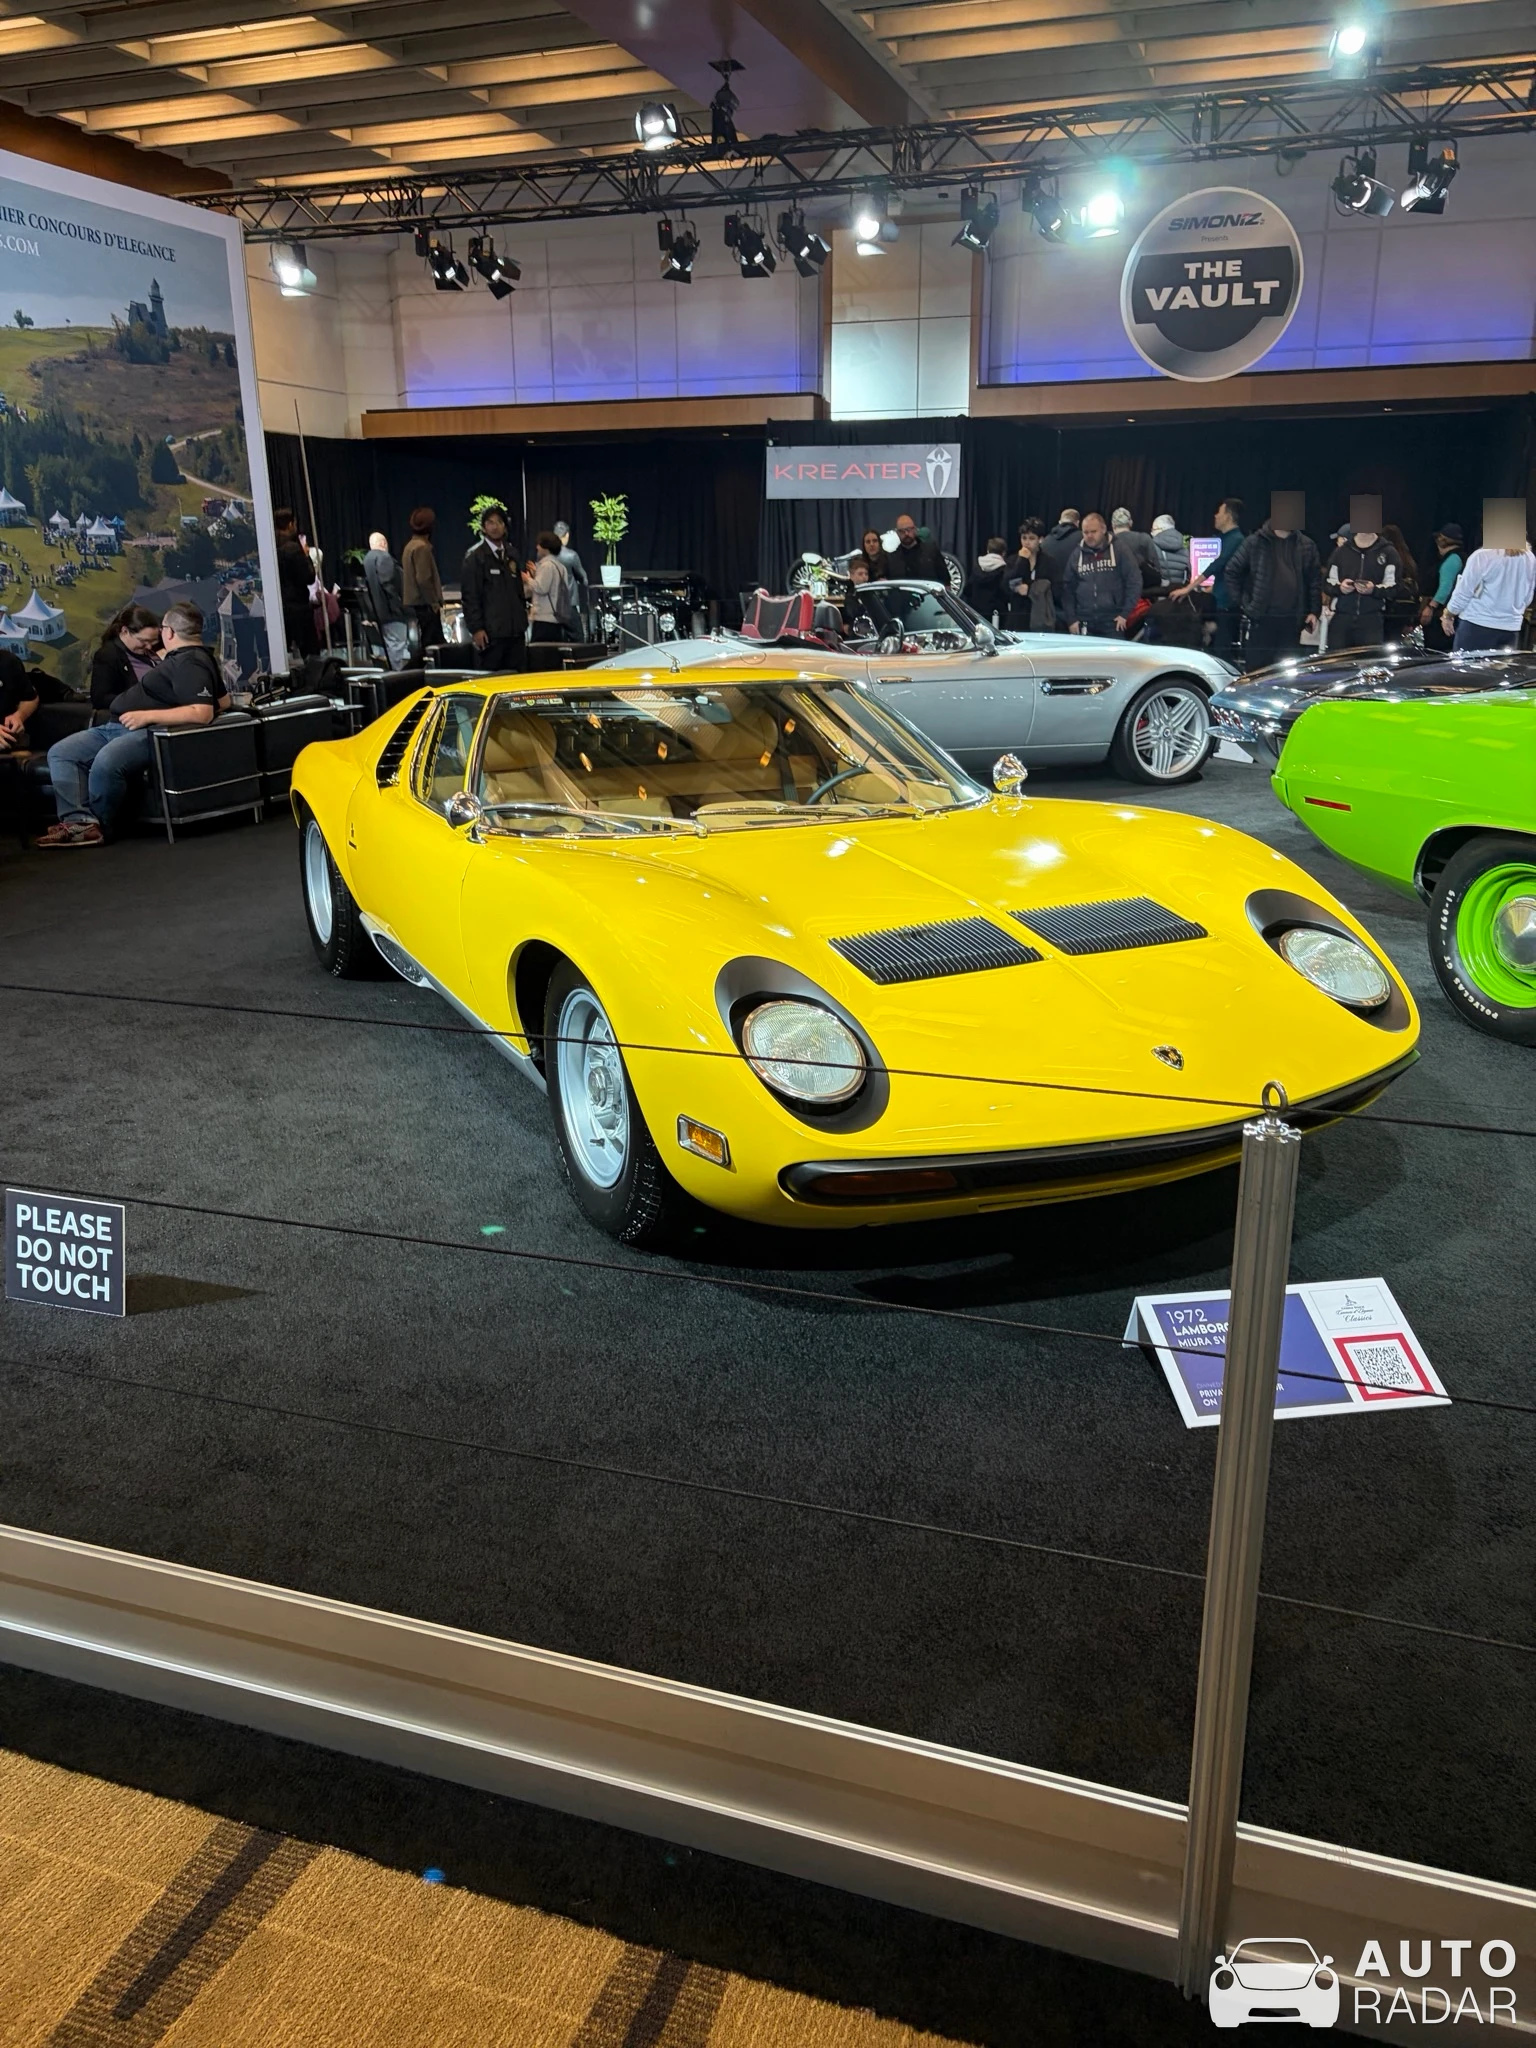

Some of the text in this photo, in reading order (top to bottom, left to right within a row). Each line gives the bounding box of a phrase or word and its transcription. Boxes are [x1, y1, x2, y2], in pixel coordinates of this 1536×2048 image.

[28, 213, 101, 244] CONCOURS
[104, 232, 176, 262] D'ELEGANCE
[1184, 260, 1243, 279] THE
[1145, 281, 1280, 311] VAULT
[774, 463, 922, 480] KREATER
[1443, 955, 1453, 969] GT
[1453, 977, 1499, 1019] POLYGLAS
[16, 1203, 112, 1241] PLEASE
[17, 1235, 113, 1271] DO NOT
[16, 1263, 110, 1302] TOUCH
[1166, 1308, 1208, 1324] 1972
[1172, 1322, 1229, 1336] LAMBOR
[1177, 1338, 1212, 1347] MIURA
[1199, 1388, 1223, 1398] PRIVA
[1203, 1398, 1218, 1406] ON
